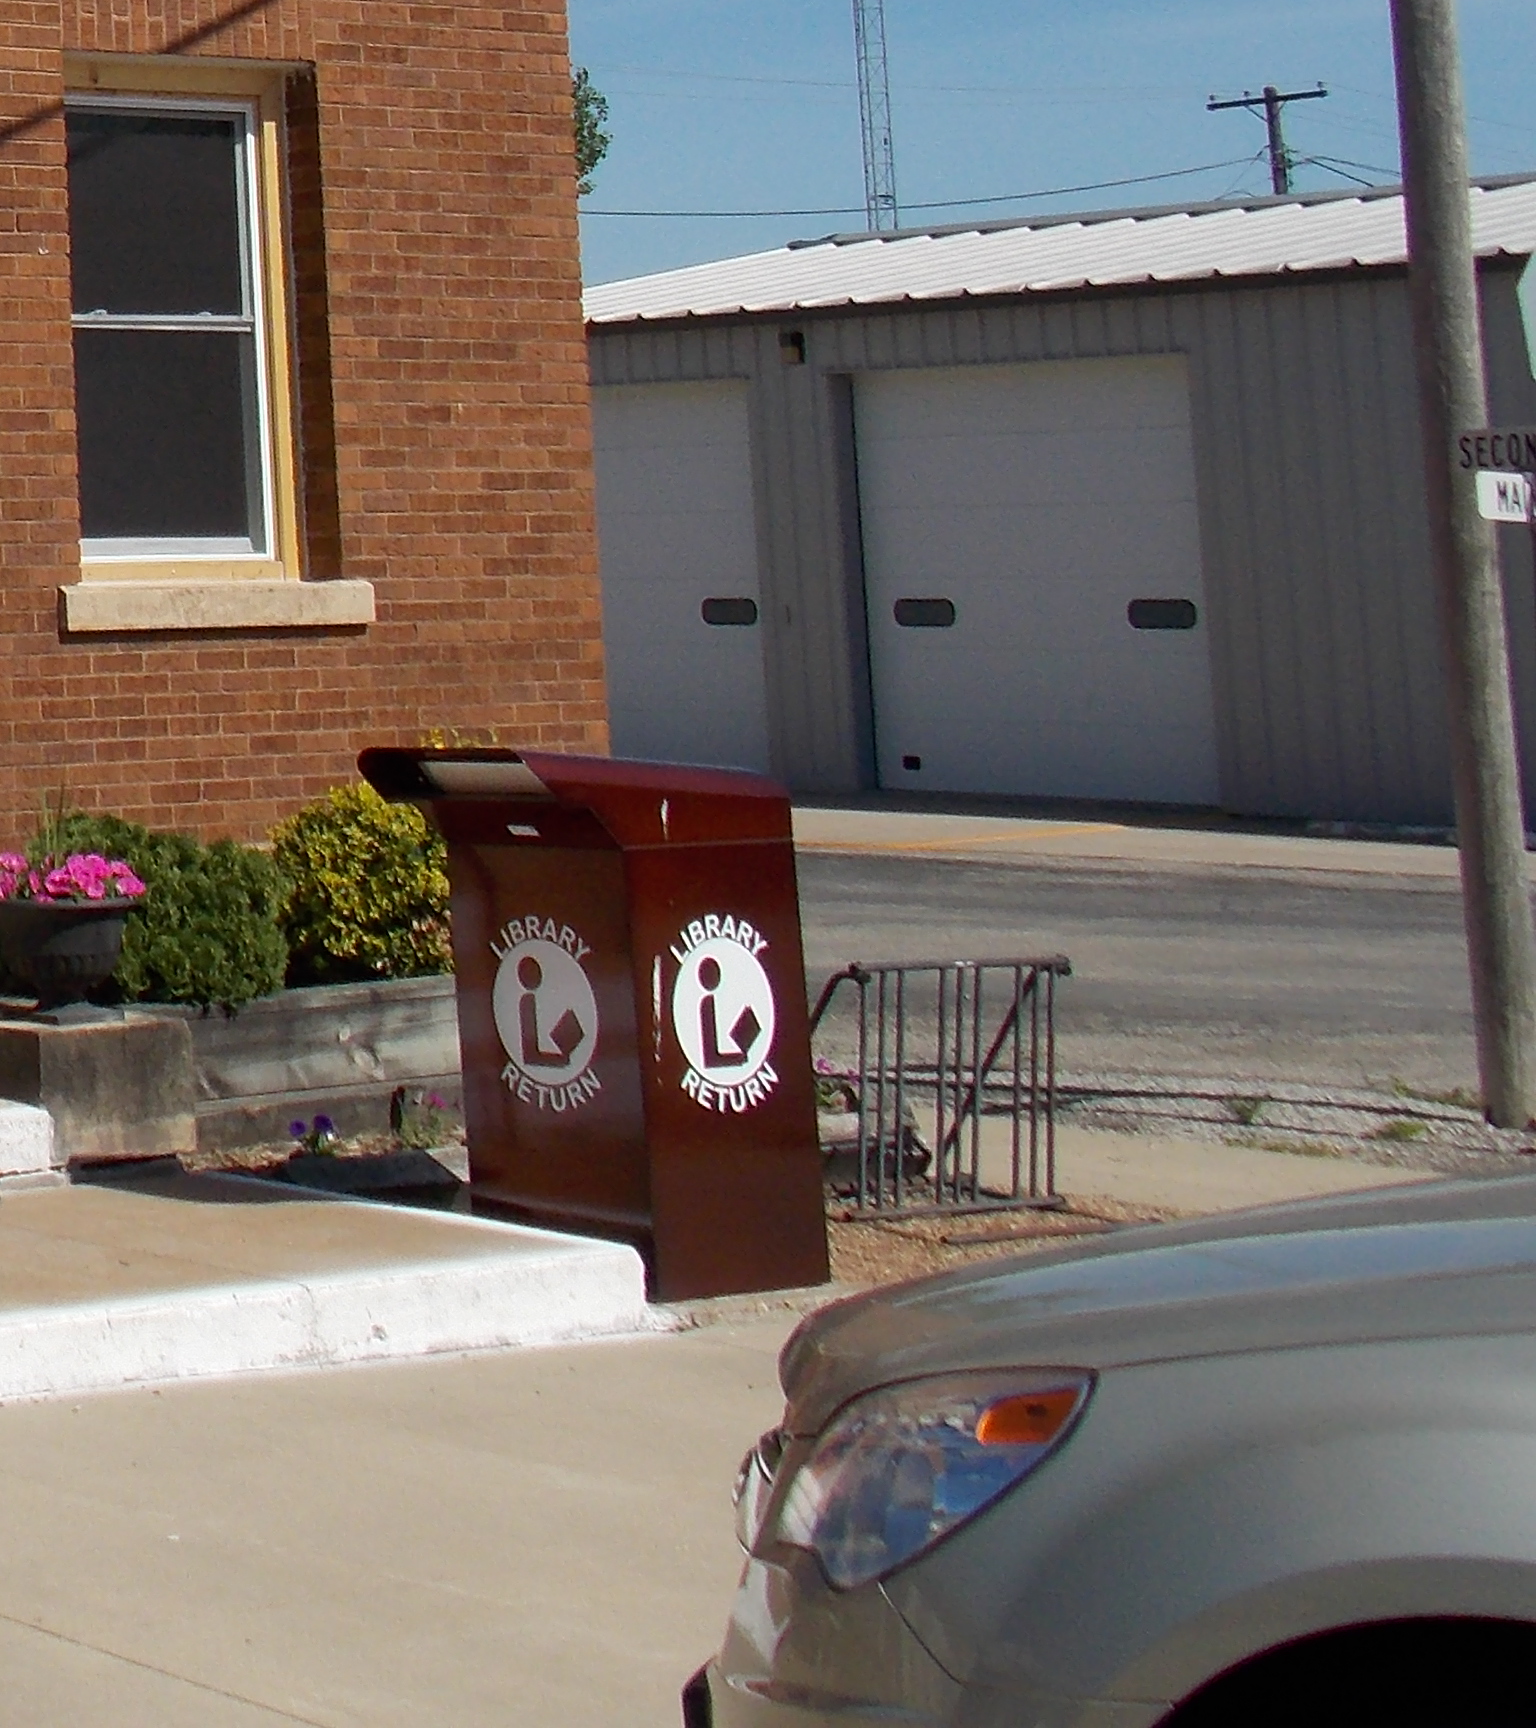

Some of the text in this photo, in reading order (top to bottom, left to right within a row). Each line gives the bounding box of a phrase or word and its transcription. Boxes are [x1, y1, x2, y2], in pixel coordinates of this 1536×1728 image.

[488, 915, 591, 961] LIBRARY
[669, 913, 768, 965] LIBRARY
[500, 1060, 603, 1113] RETURN
[680, 1061, 780, 1114] RETURN
